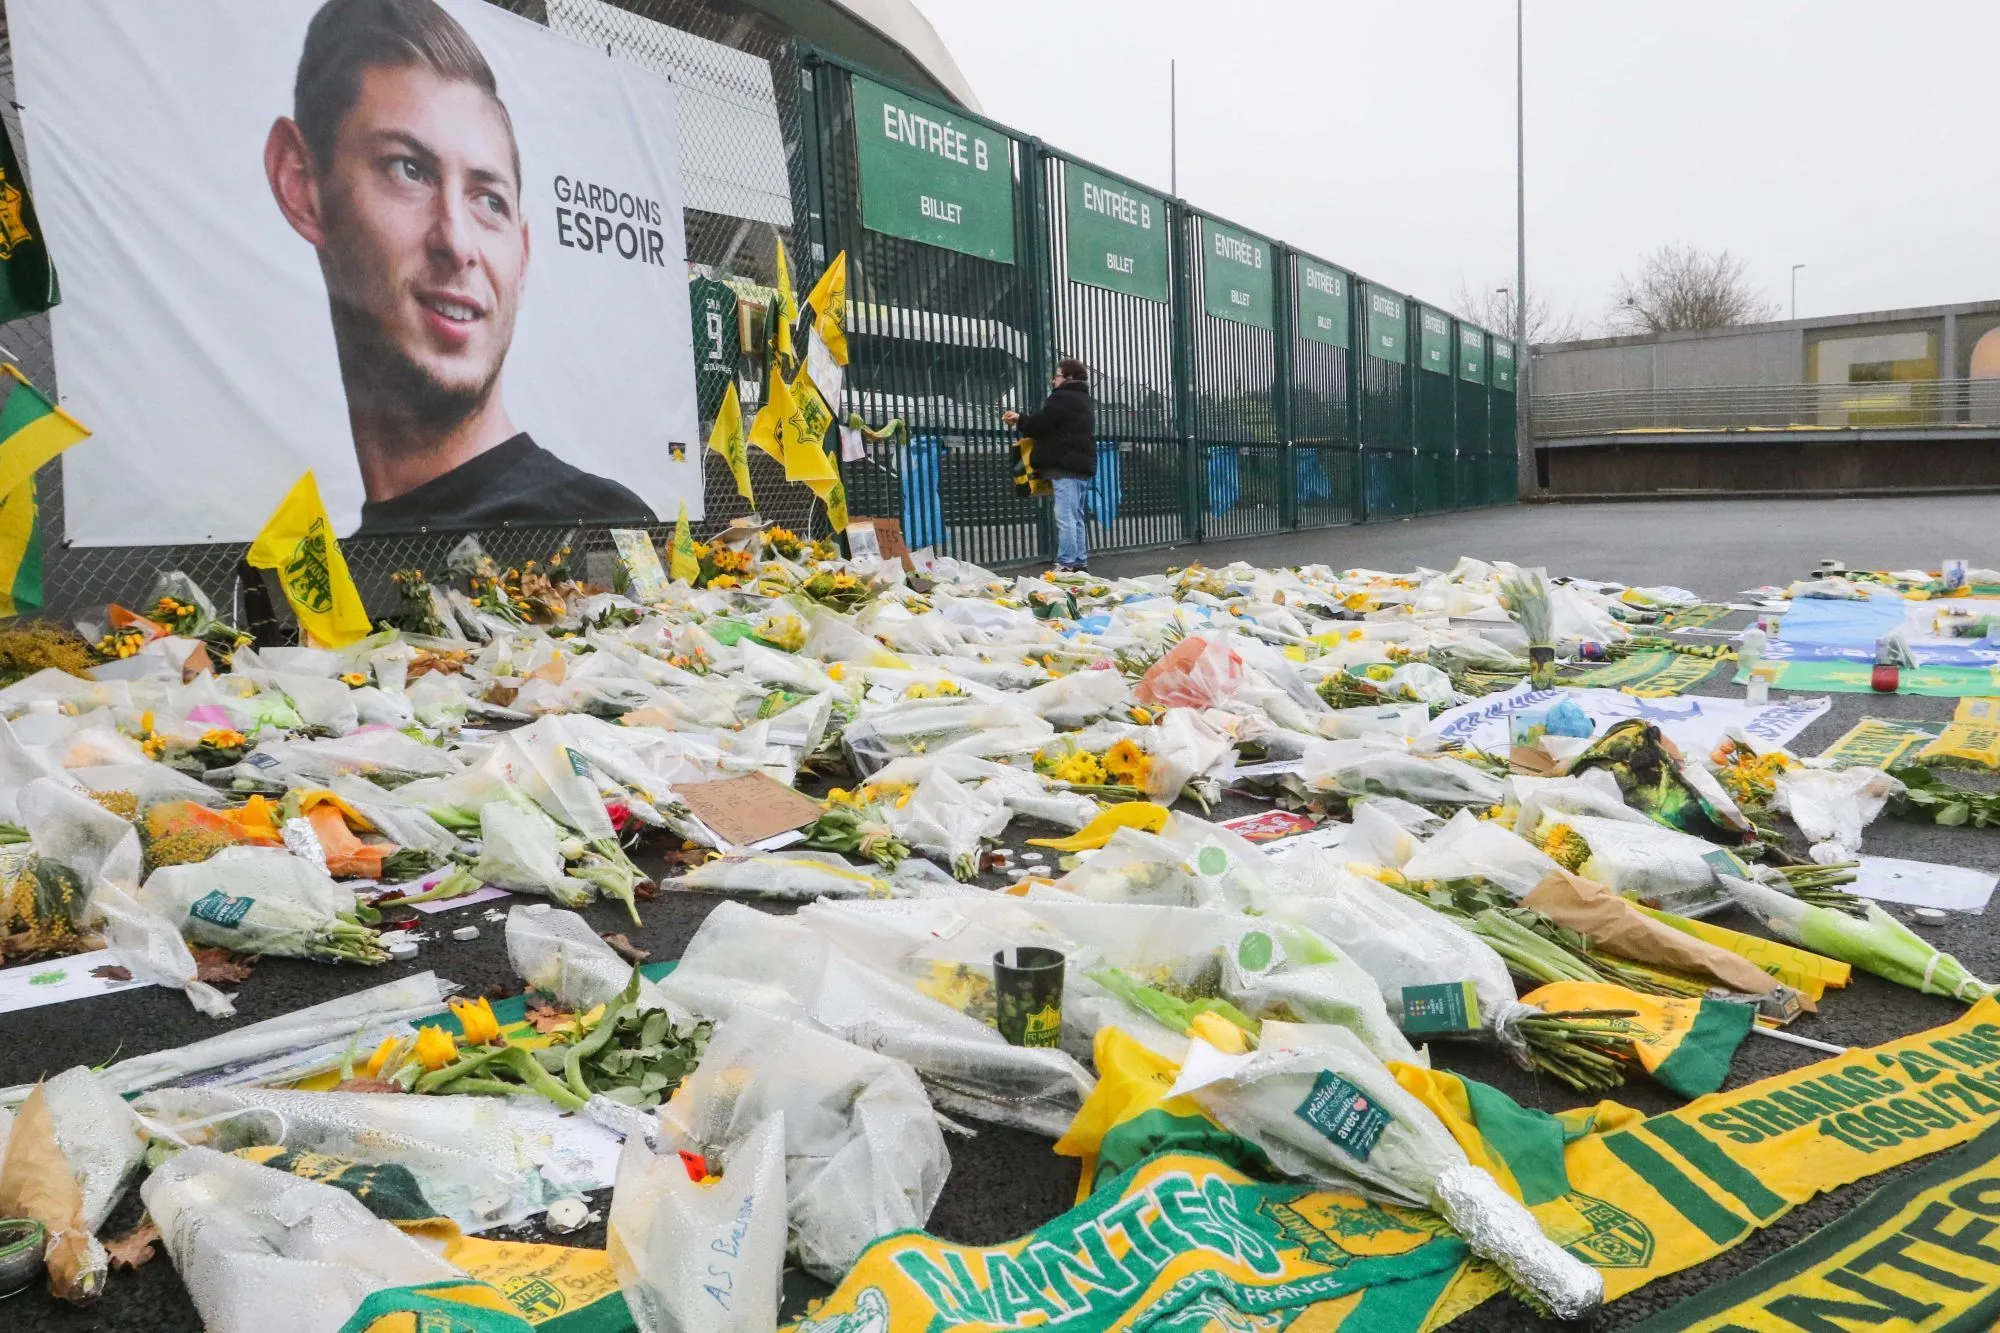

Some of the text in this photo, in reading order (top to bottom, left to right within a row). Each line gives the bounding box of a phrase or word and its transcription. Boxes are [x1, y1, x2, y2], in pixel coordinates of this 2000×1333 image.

[884, 103, 989, 171] ENTRÉE B
[554, 175, 662, 226] GARDONS
[920, 195, 963, 225] BILLET
[1084, 182, 1151, 229] ENTRÉE B
[556, 206, 665, 268] ESPOIR
[1215, 233, 1262, 269] ENTRÉE B
[1106, 252, 1134, 274] BILLET
[1306, 268, 1341, 297] ENTRÉE B
[1231, 289, 1250, 307] BILLET
[1395, 303, 1400, 320] B
[706, 312, 723, 360] 9
[1317, 315, 1332, 330] BILLET
[1337, 1111, 1361, 1140] avec
[1698, 1065, 1906, 1144] SIRANAC
[891, 1171, 1284, 1326] NANTES
[703, 1264, 733, 1312] AS
[1135, 1270, 1213, 1323] STADE
[1243, 1276, 1345, 1305] FRANCE
